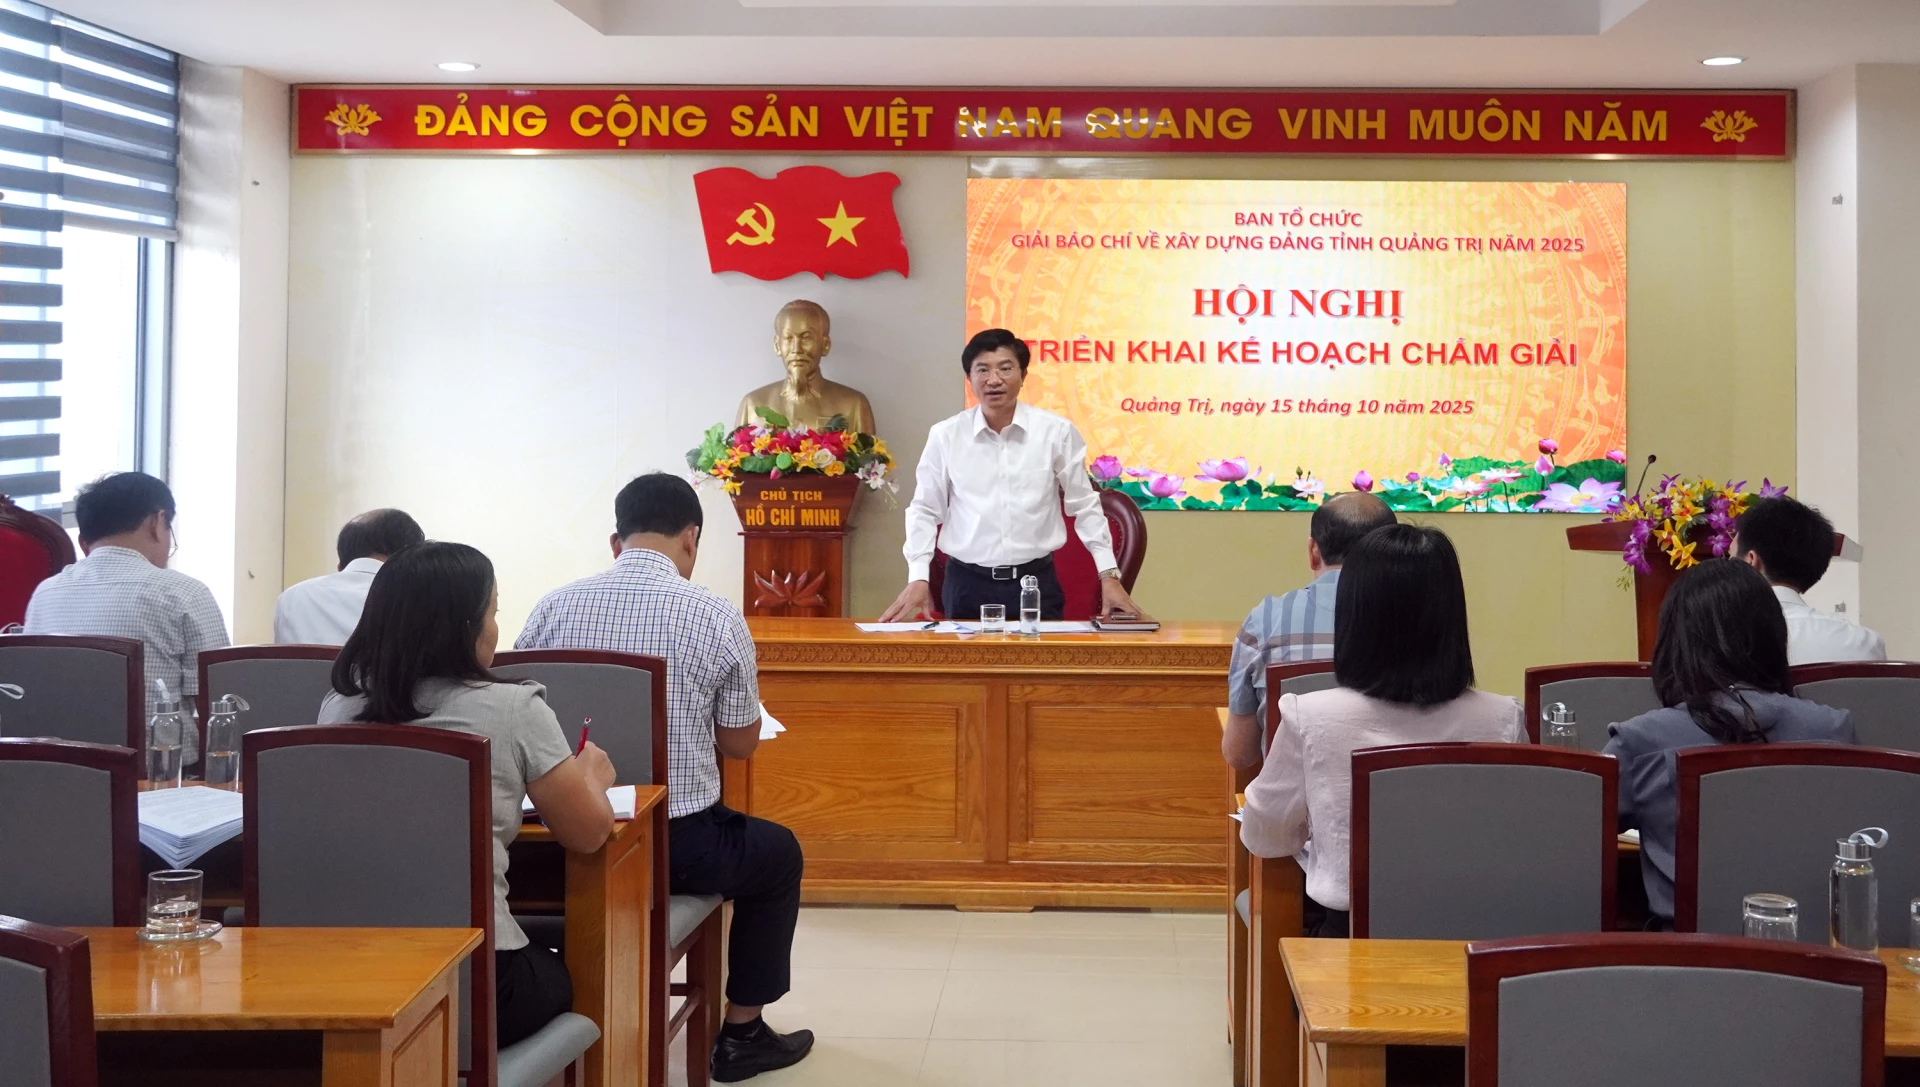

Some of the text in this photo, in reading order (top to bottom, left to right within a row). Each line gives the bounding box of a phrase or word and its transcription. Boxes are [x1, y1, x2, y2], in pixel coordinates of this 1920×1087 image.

[414, 93, 1668, 147] ĐẢNG CỘNG SẢN VIỆT NAM QUANG VINH MUÔN NĂM
[1235, 207, 1363, 227] BAN TỔ CHỨC
[1011, 229, 1584, 254] GIẢI BÁO CHÍ VỀ XÂY DỰNG ĐẢNG TỈNH QUẢNG TRỊ NĂM 2025
[1193, 283, 1404, 325] HỘI NGHỊ
[1127, 341, 1206, 363] KHAI
[1217, 335, 1260, 363] KẾ
[1271, 341, 1390, 369] HOẠCH
[1401, 337, 1499, 365] CHẤM
[1509, 337, 1577, 366] GIẢI
[1120, 396, 1474, 416] Quảng Trị, ngày 15 tháng 10 năm 2025
[760, 487, 823, 503] CHỦ TỊCH
[745, 503, 840, 526] HỒ CHÍ MINH
